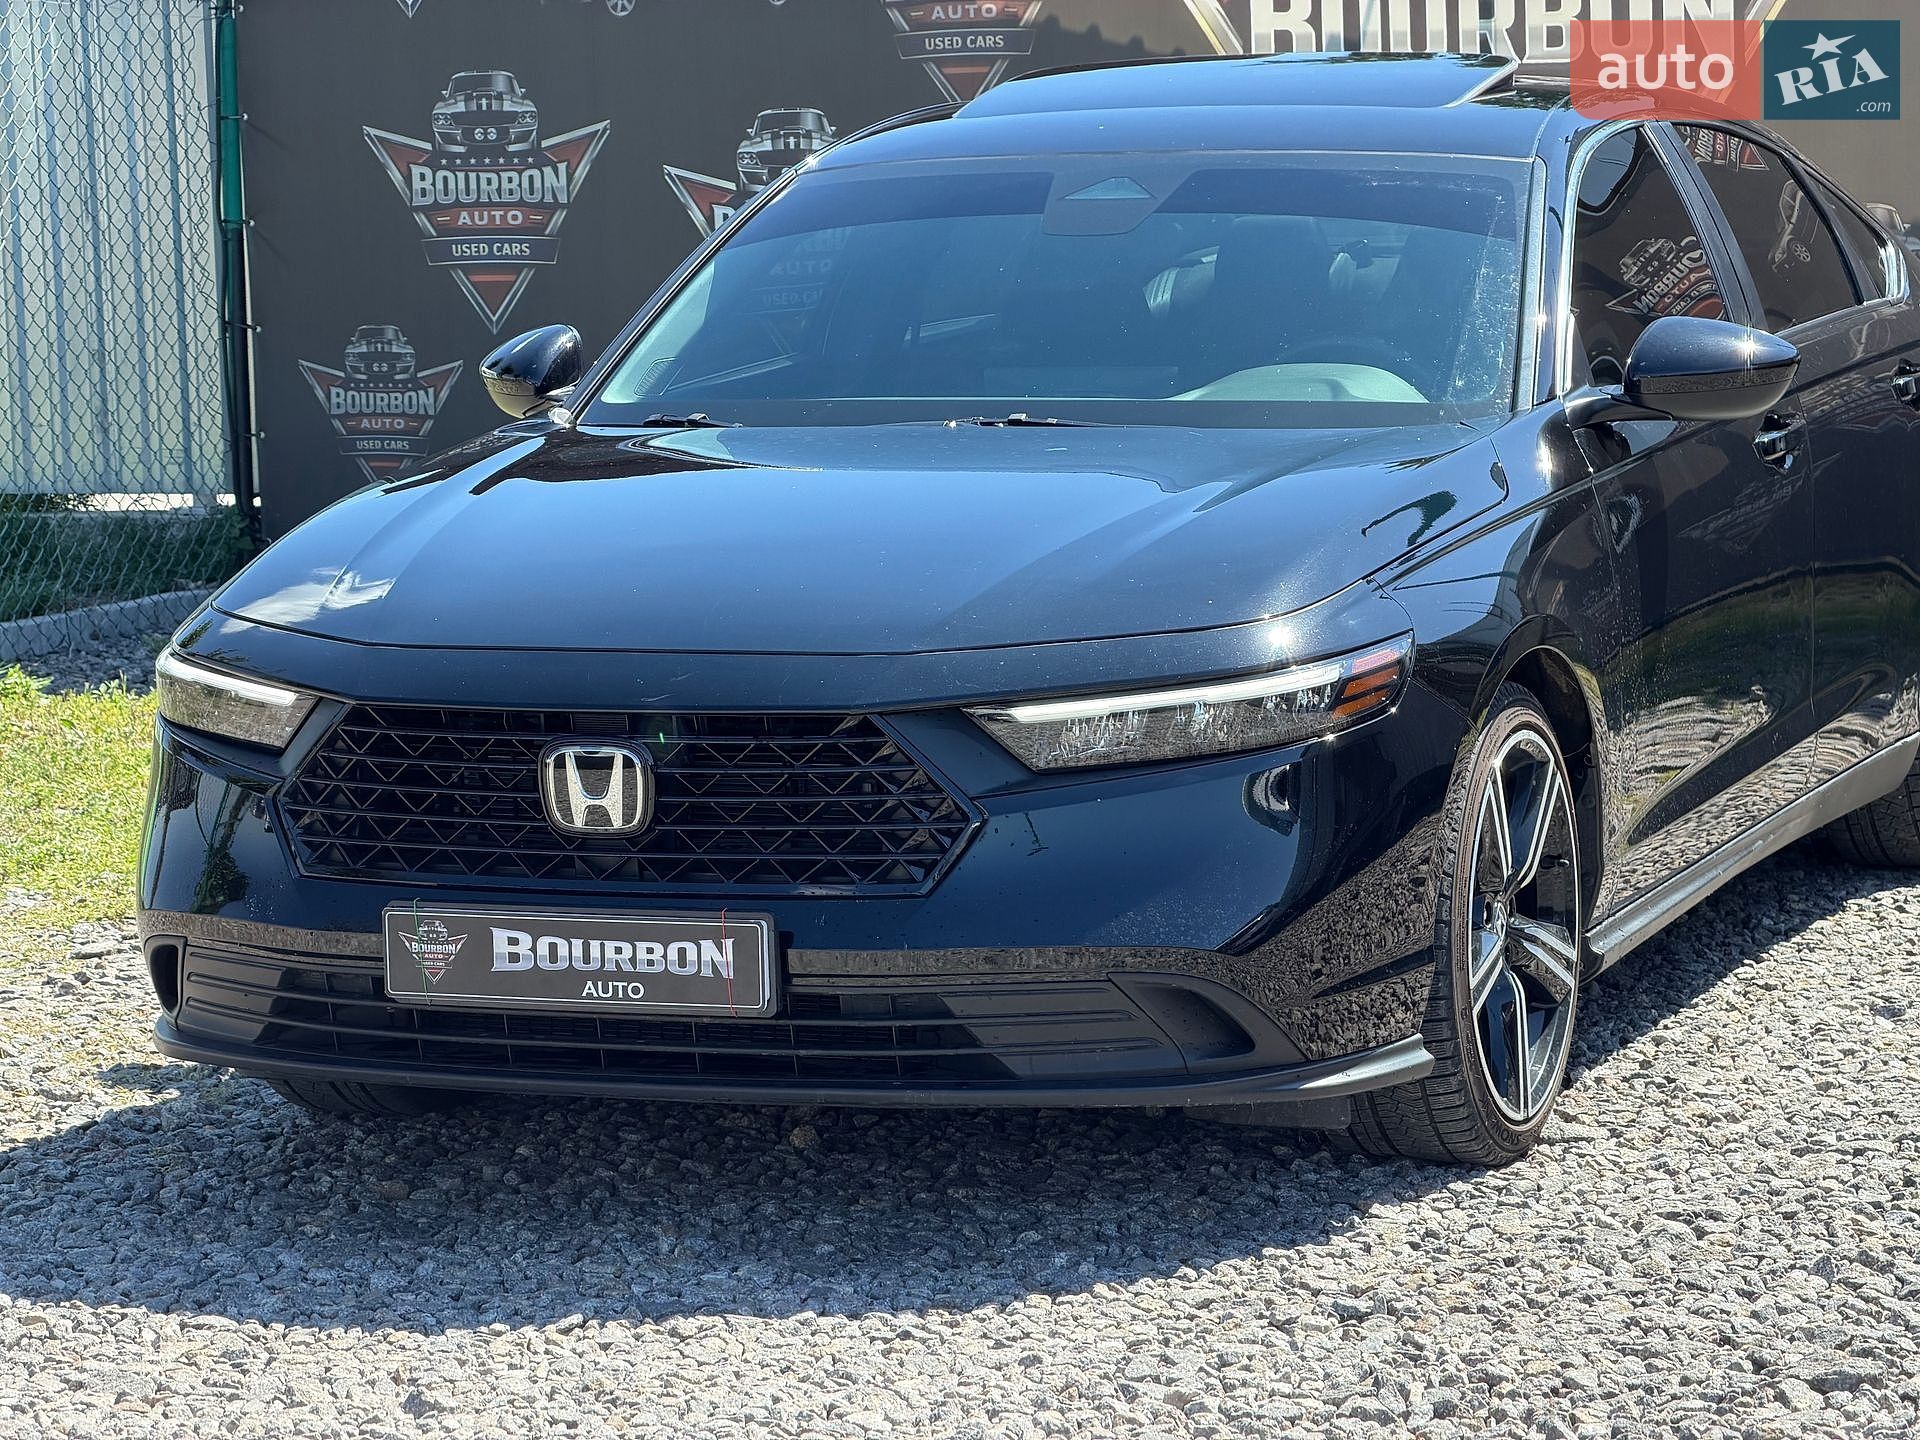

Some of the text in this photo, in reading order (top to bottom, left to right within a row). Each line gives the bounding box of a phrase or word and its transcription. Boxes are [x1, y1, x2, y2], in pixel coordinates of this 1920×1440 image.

[931, 3, 998, 20] AUTO
[925, 35, 1004, 50] USED CARS
[409, 161, 568, 206] BOURBON
[457, 210, 523, 225] AUTO
[451, 243, 530, 257] USED CARS
[329, 386, 436, 416] BOURBON
[360, 418, 405, 429] AUTO
[356, 440, 409, 450] USED CARS
[411, 941, 456, 955] BOURBON
[489, 926, 736, 979] BOURBON
[581, 980, 645, 999] AUTO
